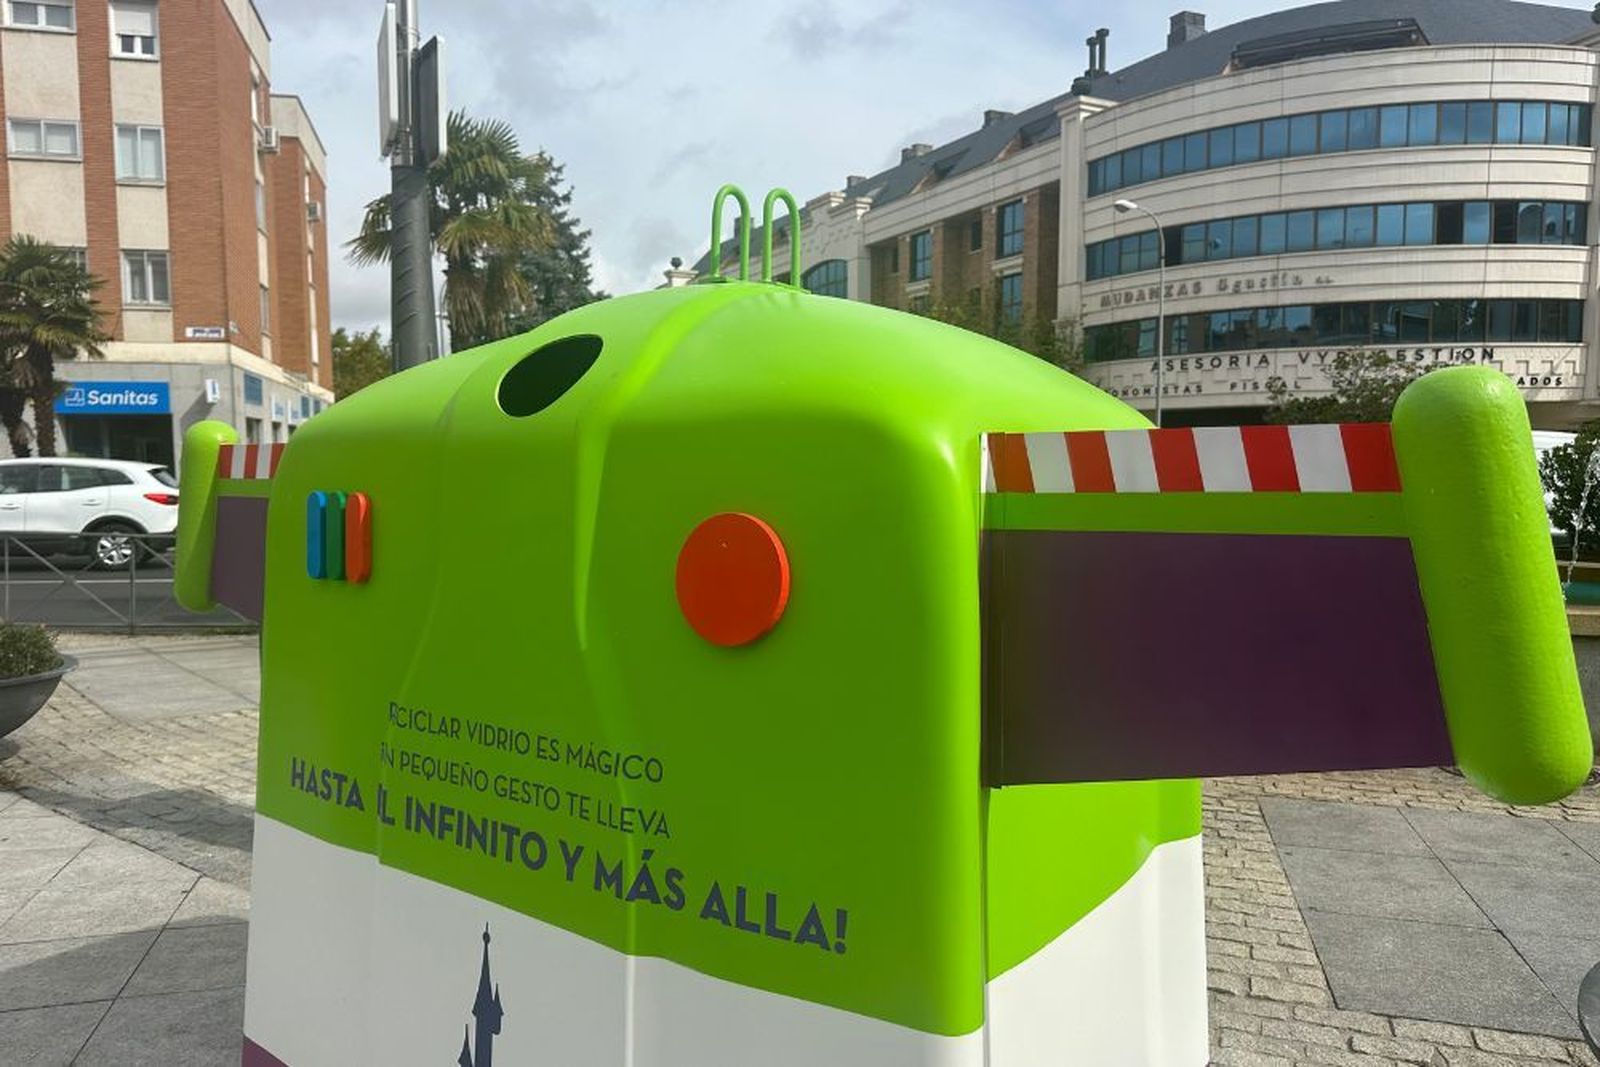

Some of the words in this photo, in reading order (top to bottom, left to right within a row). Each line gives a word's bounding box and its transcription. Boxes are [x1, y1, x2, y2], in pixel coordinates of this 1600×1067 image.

[1152, 354, 1270, 372] ASESORIA
[87, 389, 158, 406] Sanitas
[1105, 384, 1203, 398] ONOMISTAS
[389, 701, 461, 740] RCICLAR
[466, 719, 530, 755] VIDRIO
[536, 735, 560, 762] ES
[566, 742, 664, 783] MÁGICO
[400, 749, 489, 792] PEQUEÑO
[494, 774, 560, 811] GESTO
[566, 791, 590, 821] TE
[597, 798, 670, 839] LLEVA
[290, 757, 365, 812] HASTA
[404, 795, 548, 871] INFINITO
[558, 839, 585, 882] Y
[593, 849, 686, 911] MÁS
[699, 880, 849, 955] ALLA!
